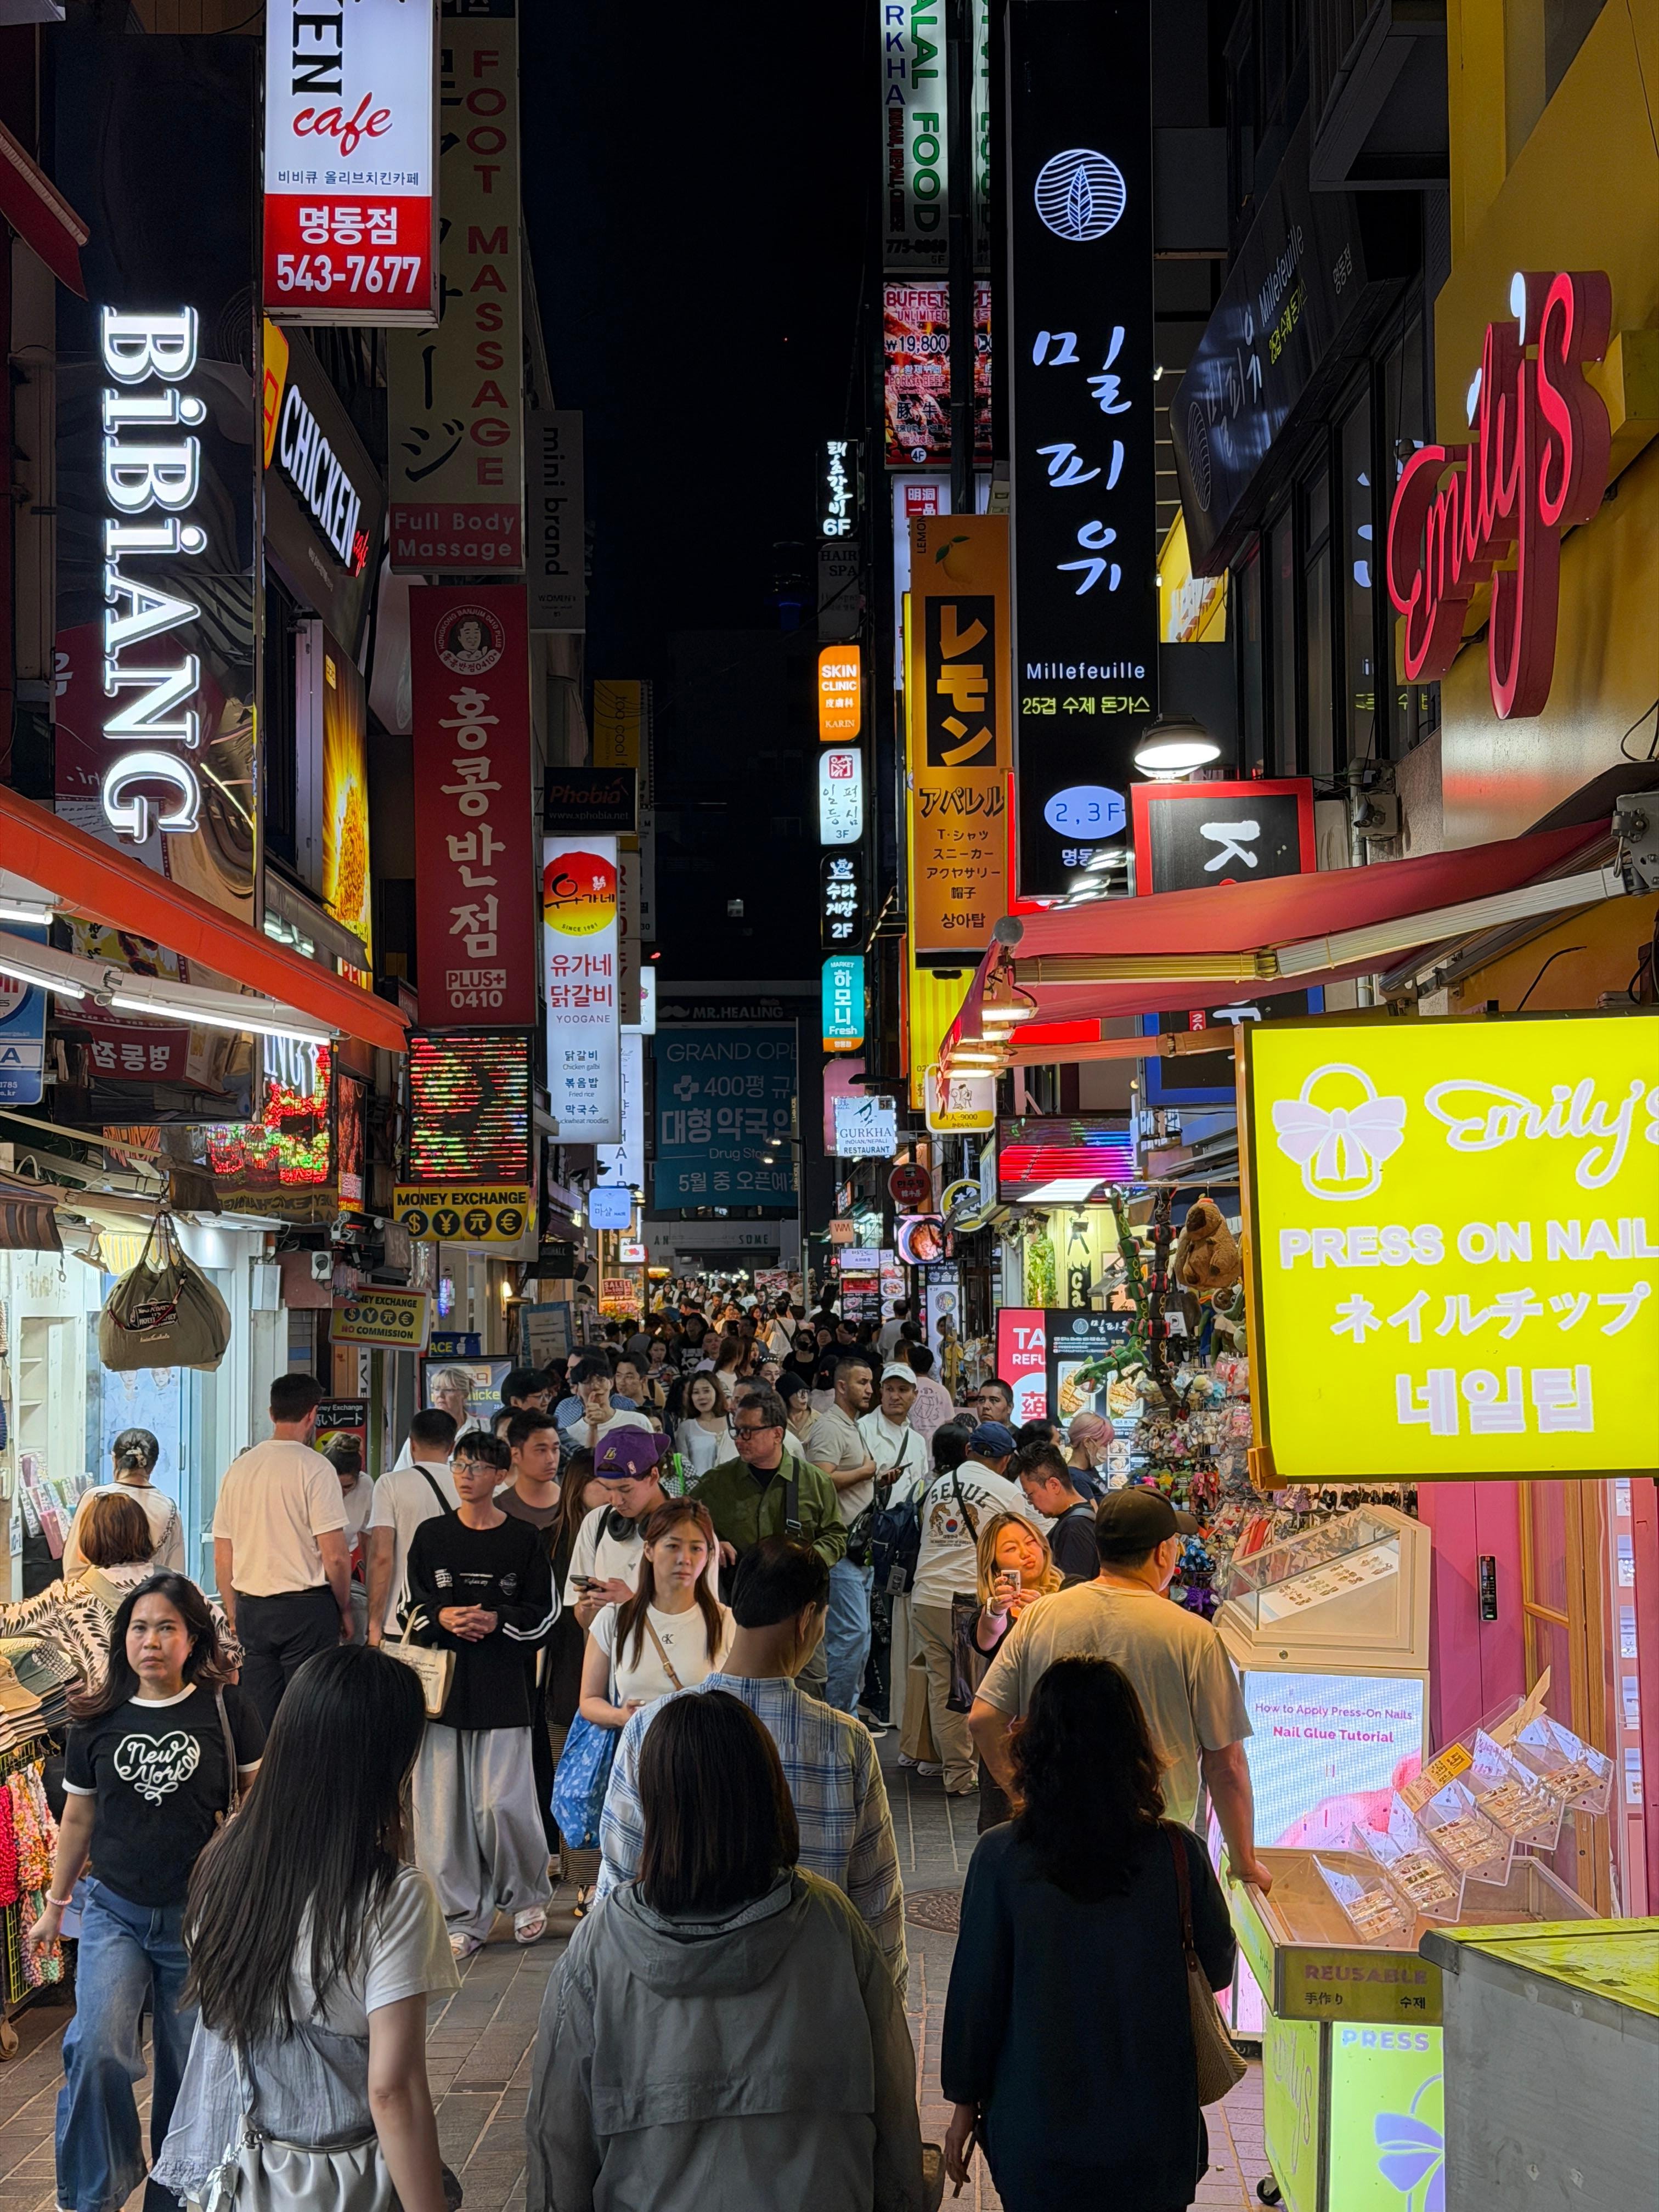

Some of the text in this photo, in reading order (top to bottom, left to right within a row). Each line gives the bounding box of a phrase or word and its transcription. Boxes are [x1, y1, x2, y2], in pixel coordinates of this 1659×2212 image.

[292, 0, 343, 96] EN
[292, 92, 393, 157] cafe
[466, 49, 507, 194] FOOT
[278, 170, 420, 187] 비비큐 올리브치킨카페
[912, 112, 940, 233] FOOD
[298, 207, 398, 245] 명동점
[277, 255, 421, 294] 543-7677
[886, 291, 947, 307] BUFFET
[897, 311, 948, 321] UNLIMITED
[467, 225, 511, 486] MASSAGE
[280, 385, 360, 568] CHICKEN
[543, 427, 569, 575] mini brand
[394, 512, 515, 534] Full Body
[823, 518, 851, 536] 6F
[917, 516, 927, 554] LEMON
[398, 539, 512, 561] Massage
[821, 550, 857, 561] HAIR
[829, 566, 856, 576] SPA
[821, 664, 857, 678] SKIN
[1027, 662, 1146, 680] Millefeuille
[821, 681, 857, 691] CLINIC
[936, 605, 993, 766] レモン
[1022, 696, 1151, 715] 25겹 수제 돈가스
[825, 720, 855, 728] KARIN
[549, 783, 621, 805] Phobia
[919, 786, 1005, 818] アパレル
[438, 686, 506, 958] 홍콩반점
[836, 830, 849, 838] 3F
[932, 848, 994, 860] スニーカー
[826, 883, 857, 900] 수라
[951, 887, 977, 899] 帽子
[941, 913, 986, 929] 상아탑
[831, 923, 854, 938] 2F
[550, 953, 612, 977] 유가네
[447, 972, 505, 988] PLUS+
[450, 990, 503, 1008] 0410
[550, 984, 612, 1008] 닭갈비
[834, 969, 852, 1025] 하모니
[556, 1014, 611, 1024] YOOGANE
[829, 1025, 857, 1035] Fresh
[565, 1049, 599, 1062] 닭갈비
[667, 1042, 751, 1062] GRAND
[586, 1063, 600, 1071] galbi
[565, 1077, 599, 1090] 볶음밥
[704, 1075, 764, 1098] 400평
[565, 1104, 599, 1116] 막국수
[839, 1127, 892, 1138] GURKHA
[709, 1148, 741, 1161] Drug
[843, 1146, 890, 1154] RESTAURANT
[679, 1172, 707, 1192] 5월
[713, 1171, 731, 1191] 중
[397, 1190, 527, 1206] MONEY EXCHANGE
[1279, 1224, 1446, 1269] PRESS
[1457, 1221, 1533, 1264] ON
[360, 1295, 417, 1308] NEY EXCHANGE
[1330, 1280, 1651, 1344] ネイルチップ
[341, 1325, 413, 1339] NO COMMISSION
[1395, 1364, 1595, 1436] 네일팁
[1255, 1702, 1412, 1720] How to Apply Press-On Nails
[1273, 1725, 1394, 1743] Nail Glue Tutorial
[127, 1741, 179, 1764] New
[1305, 1965, 1427, 1985] REUSABLE
[1304, 1992, 1344, 2006] 手作り
[1400, 1996, 1426, 2010] 수제
[1341, 2029, 1430, 2052] PRESS
